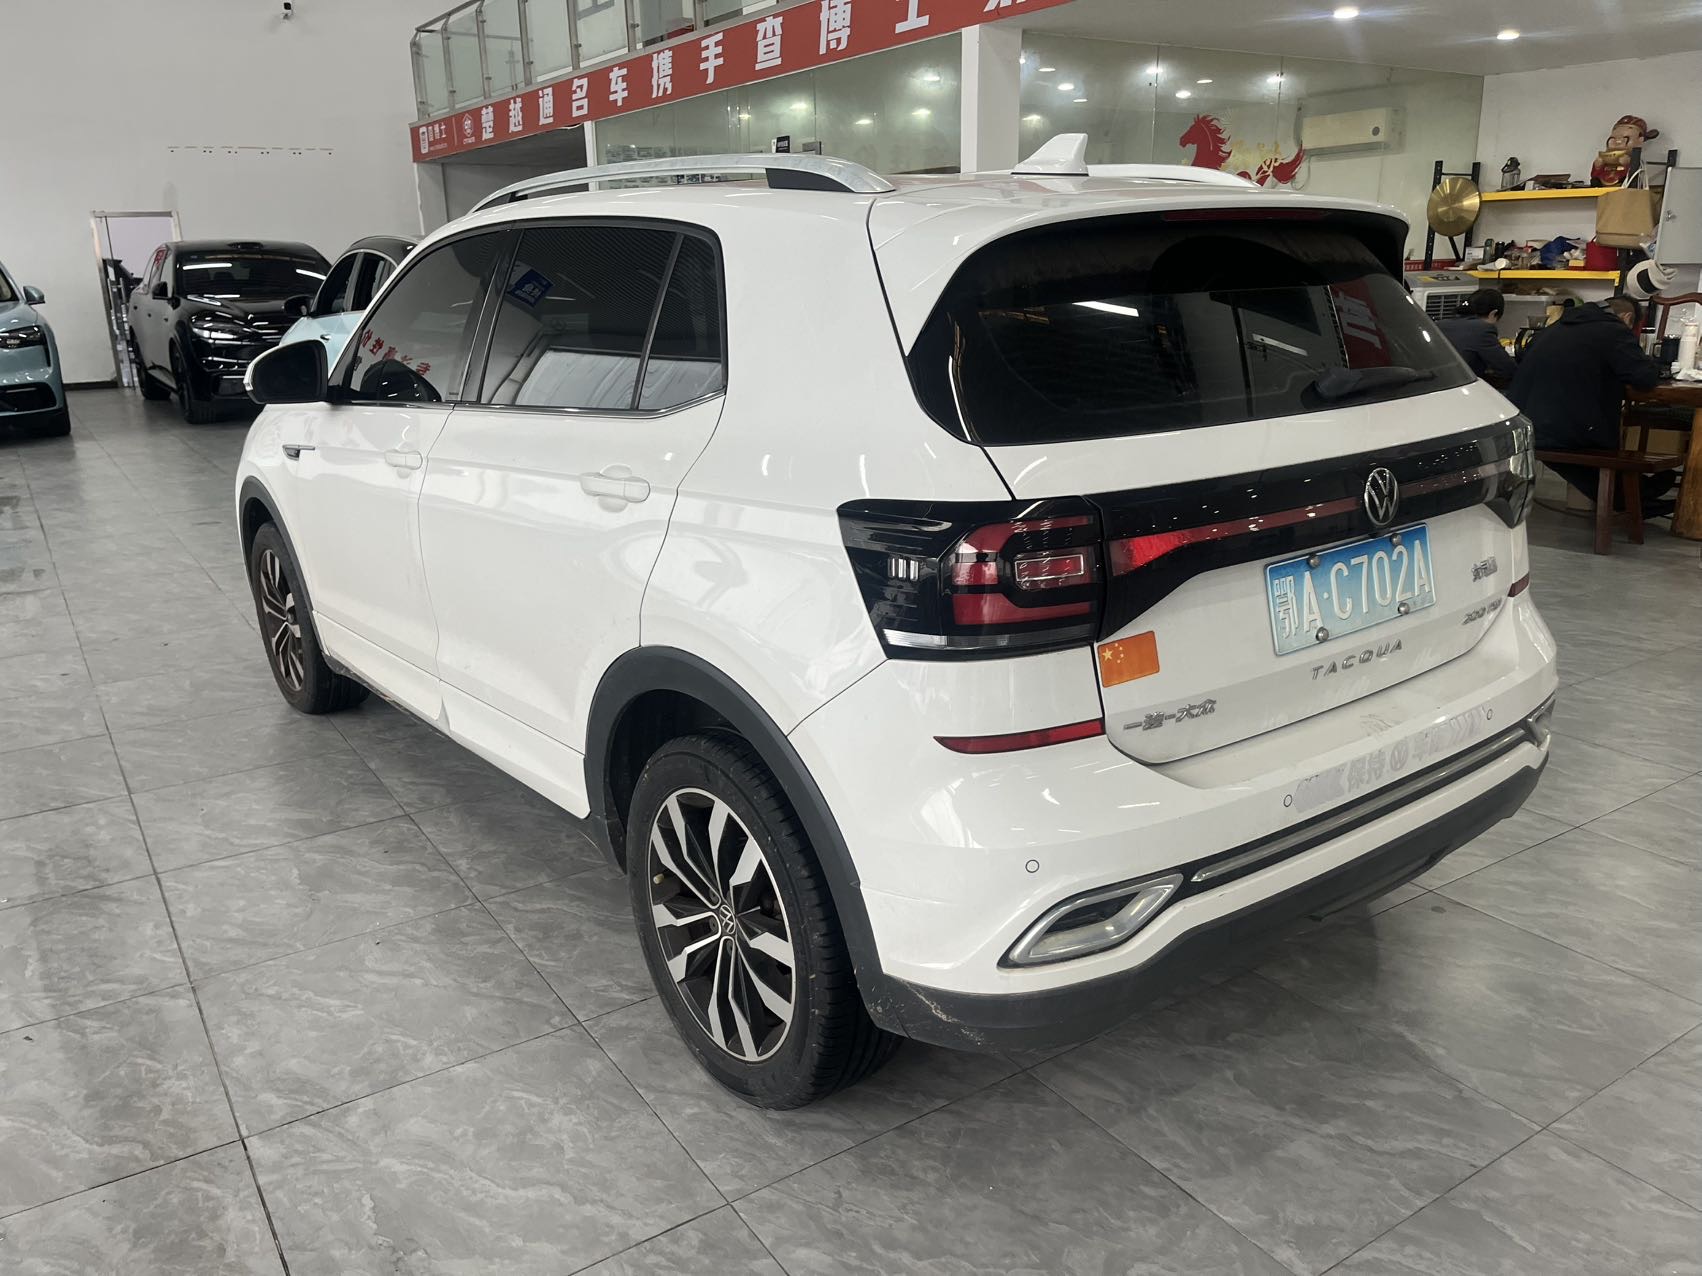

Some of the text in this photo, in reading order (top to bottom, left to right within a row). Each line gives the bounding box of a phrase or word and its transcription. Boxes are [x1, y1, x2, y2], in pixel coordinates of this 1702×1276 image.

[481, 0, 1026, 141] 楚越通名车携手查博士
[1311, 639, 1404, 680] TACQUA
